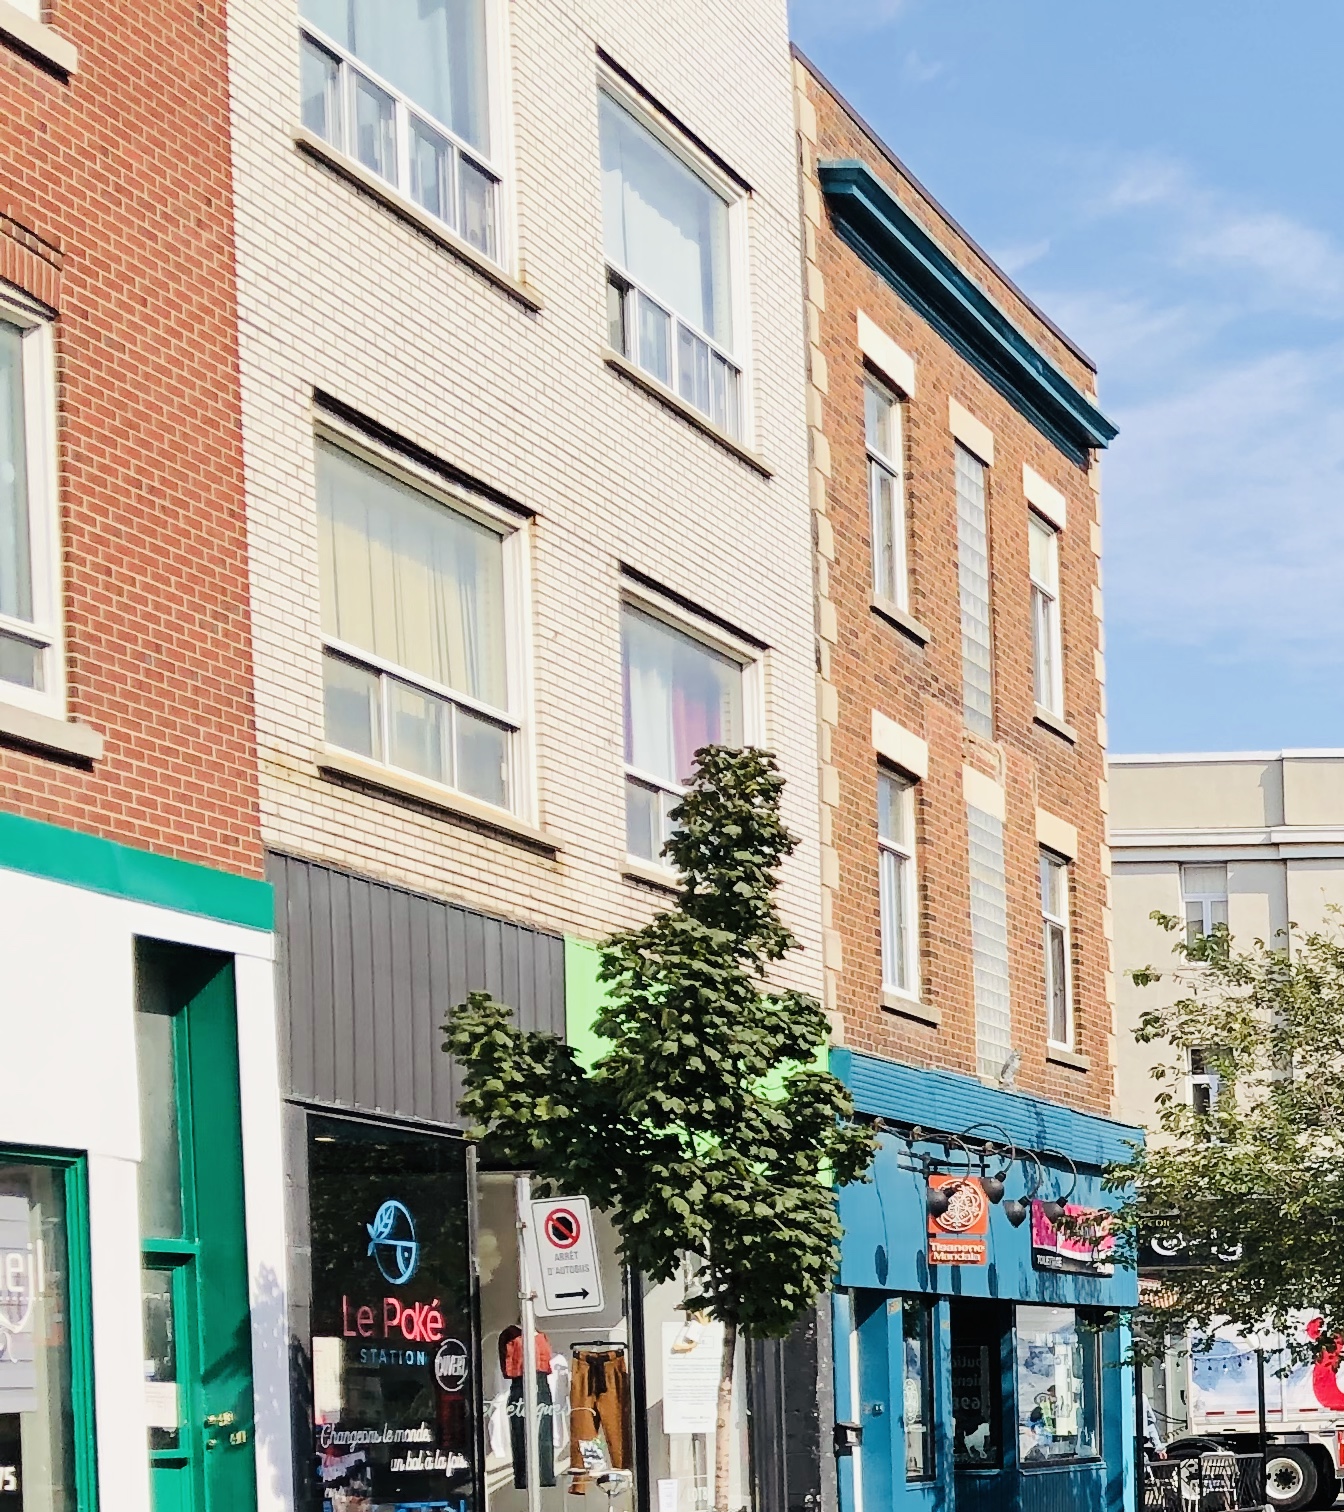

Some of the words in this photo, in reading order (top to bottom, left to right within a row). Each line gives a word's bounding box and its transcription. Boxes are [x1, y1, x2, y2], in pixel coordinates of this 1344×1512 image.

[0, 1239, 45, 1293] eil
[342, 1294, 375, 1338] Le
[383, 1298, 446, 1343] Poké
[360, 1348, 425, 1366] STATION
[382, 1422, 394, 1443] le
[390, 1457, 405, 1472] un
[406, 1450, 424, 1471] bol
[434, 1449, 446, 1470] la
